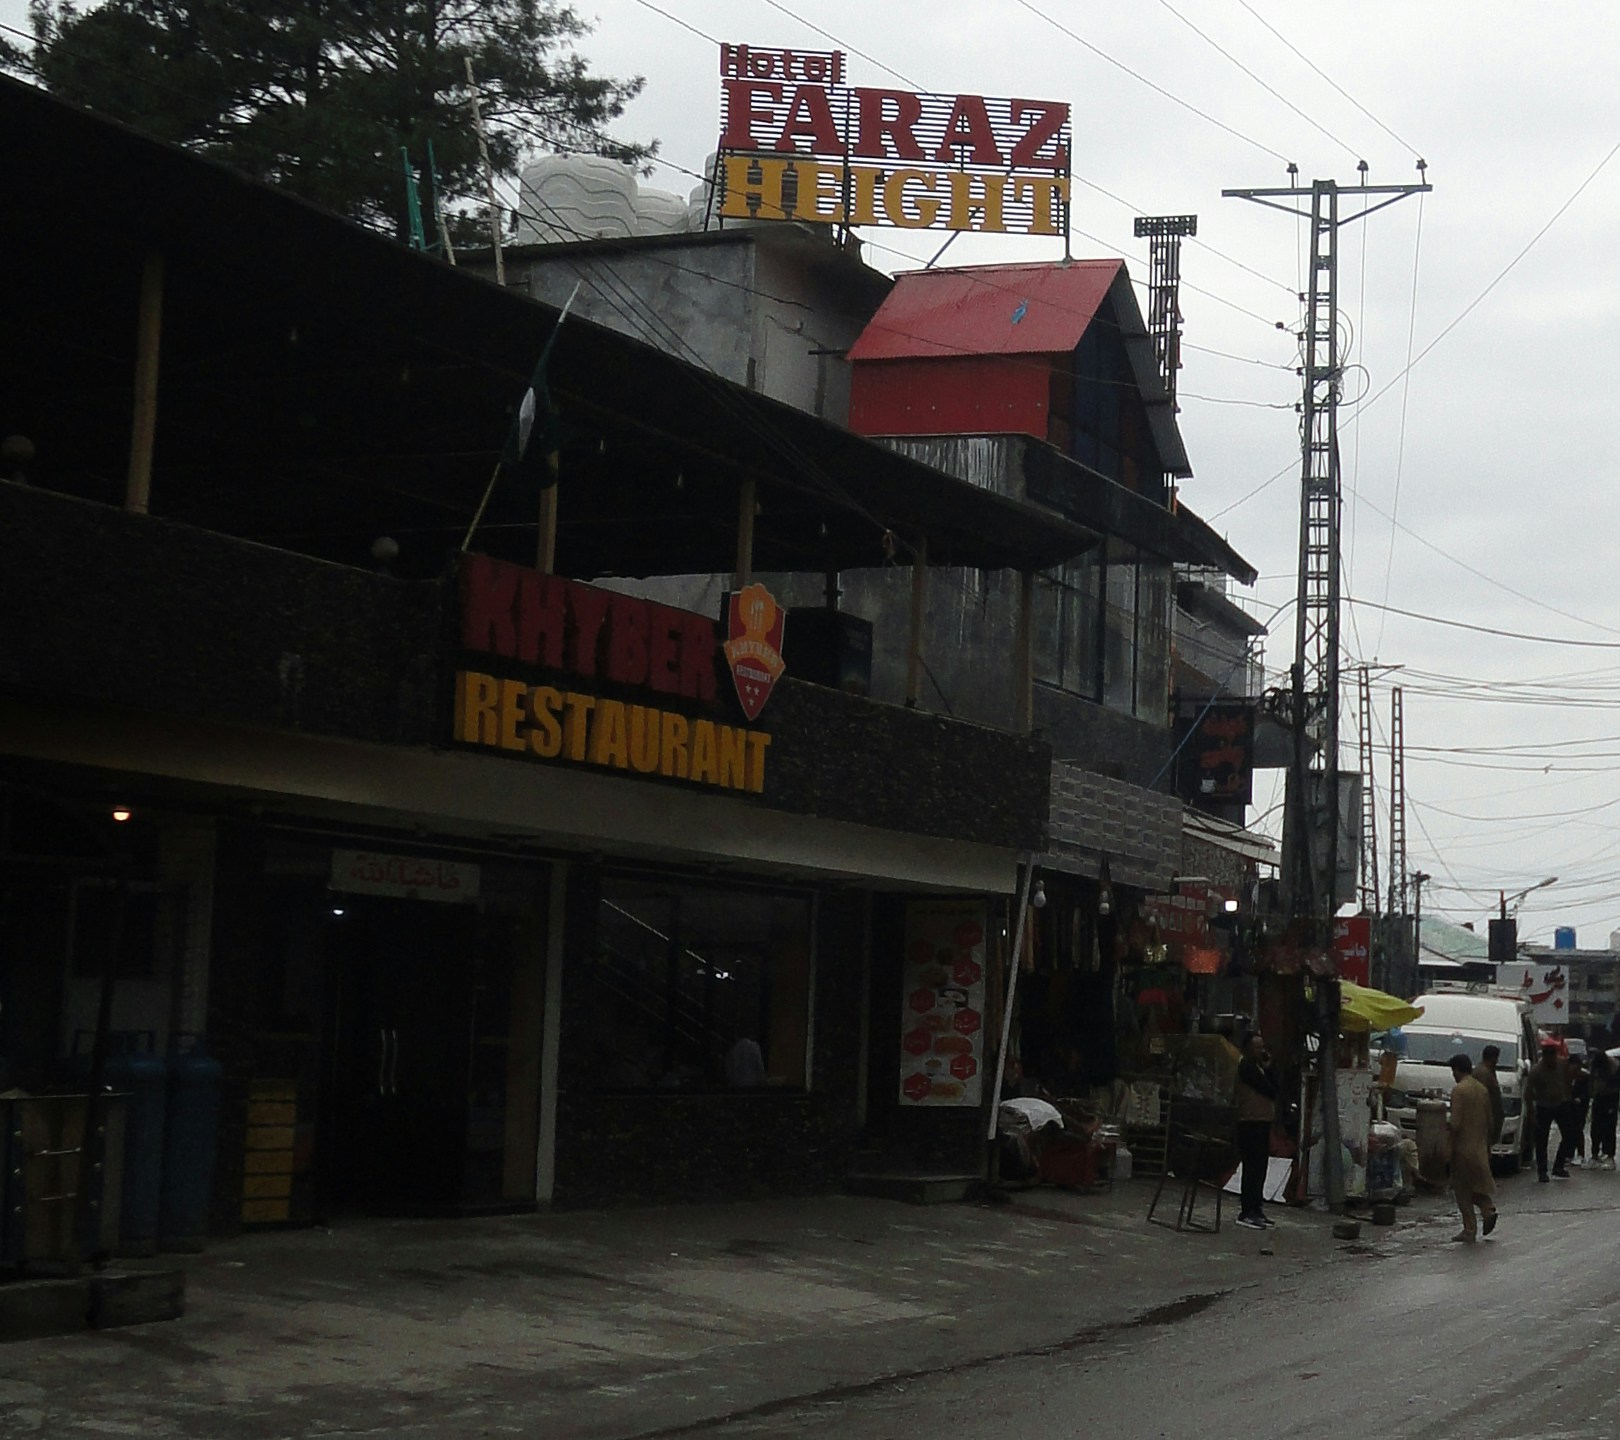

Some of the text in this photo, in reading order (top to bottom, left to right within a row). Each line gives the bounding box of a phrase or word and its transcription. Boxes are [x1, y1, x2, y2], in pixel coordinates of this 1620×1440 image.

[720, 42, 847, 85] Hotel
[720, 78, 1071, 170] FARAZ
[719, 155, 1070, 237] HEIGHT
[458, 553, 720, 704] KHYBER
[453, 669, 773, 795] RESTAURANT
